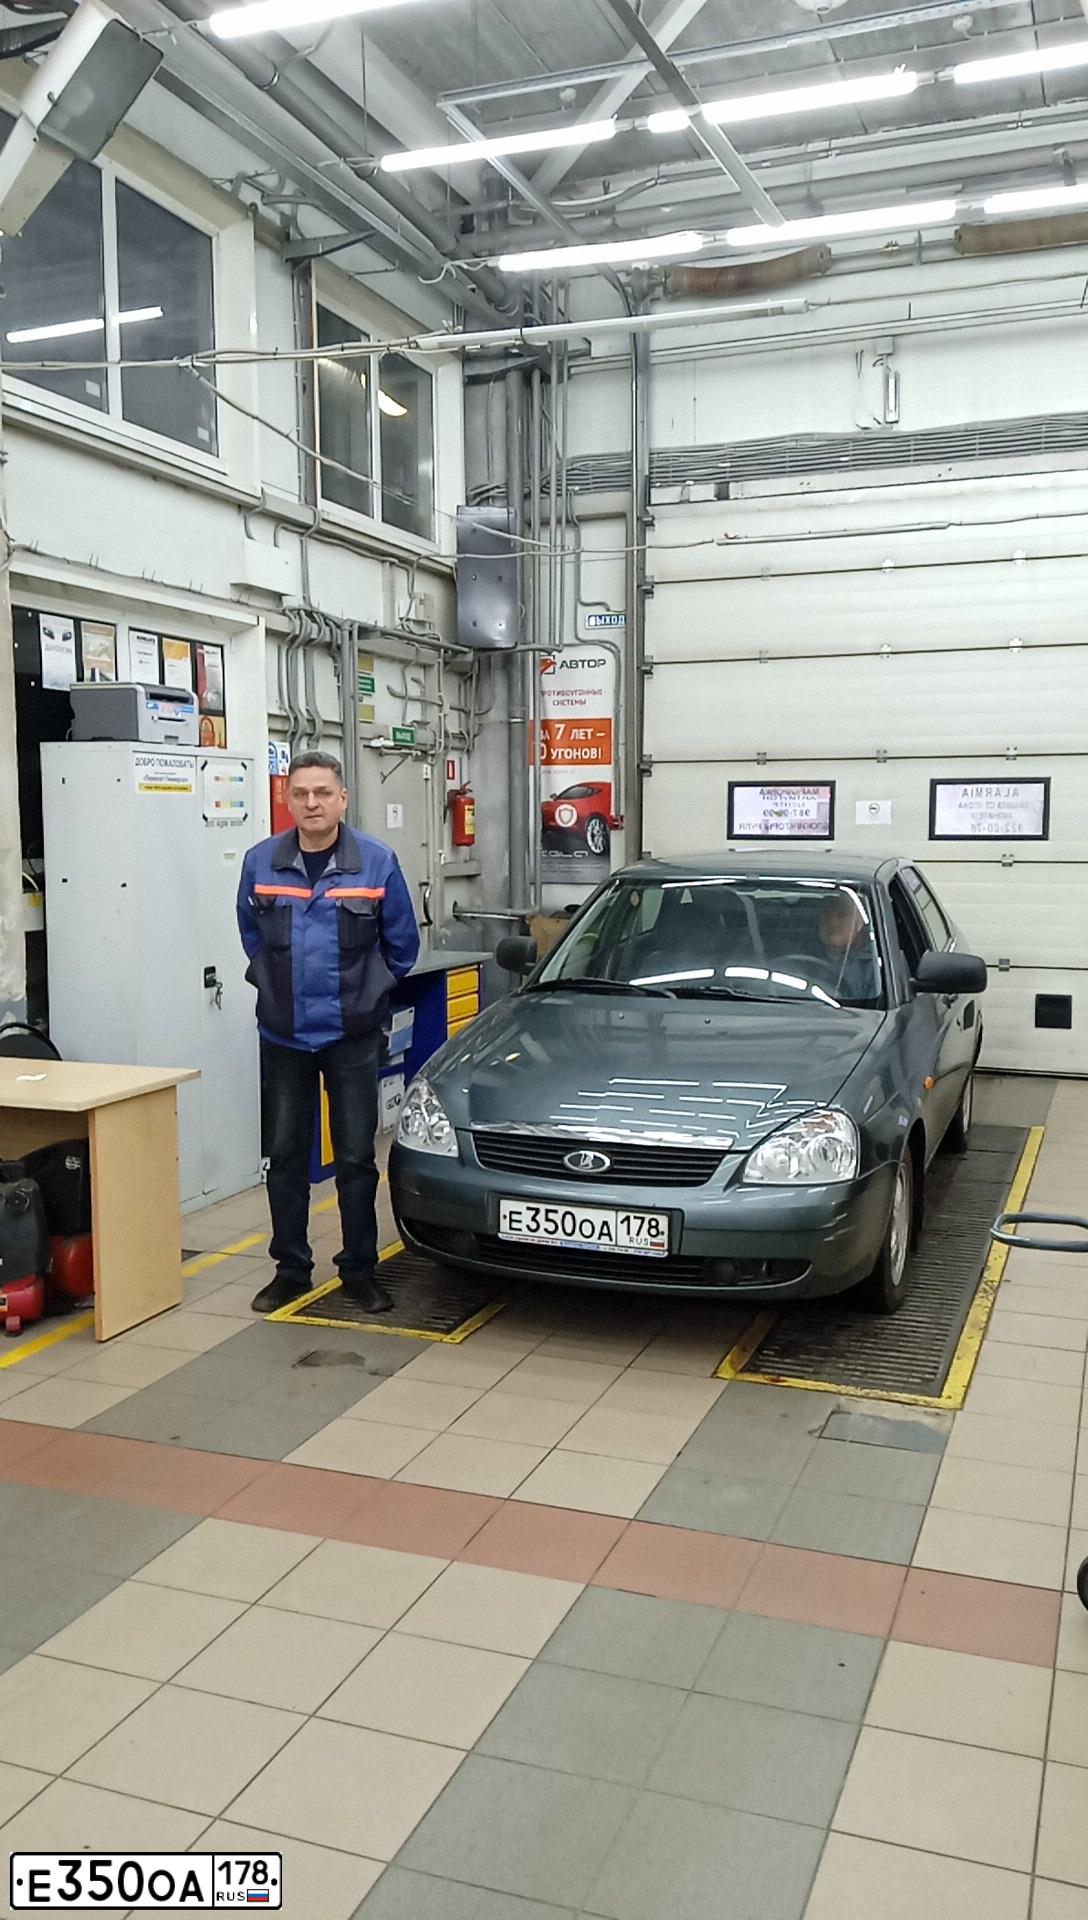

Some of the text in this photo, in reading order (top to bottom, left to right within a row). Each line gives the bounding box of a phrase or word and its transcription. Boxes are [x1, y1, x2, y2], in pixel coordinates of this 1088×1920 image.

[559, 658, 607, 670] АВТОР
[555, 723, 566, 740] 7
[570, 728, 594, 740] ЛЕТ
[508, 1206, 613, 1242] Е350ОА
[620, 1214, 660, 1238] 178
[628, 1236, 649, 1246] RUS
